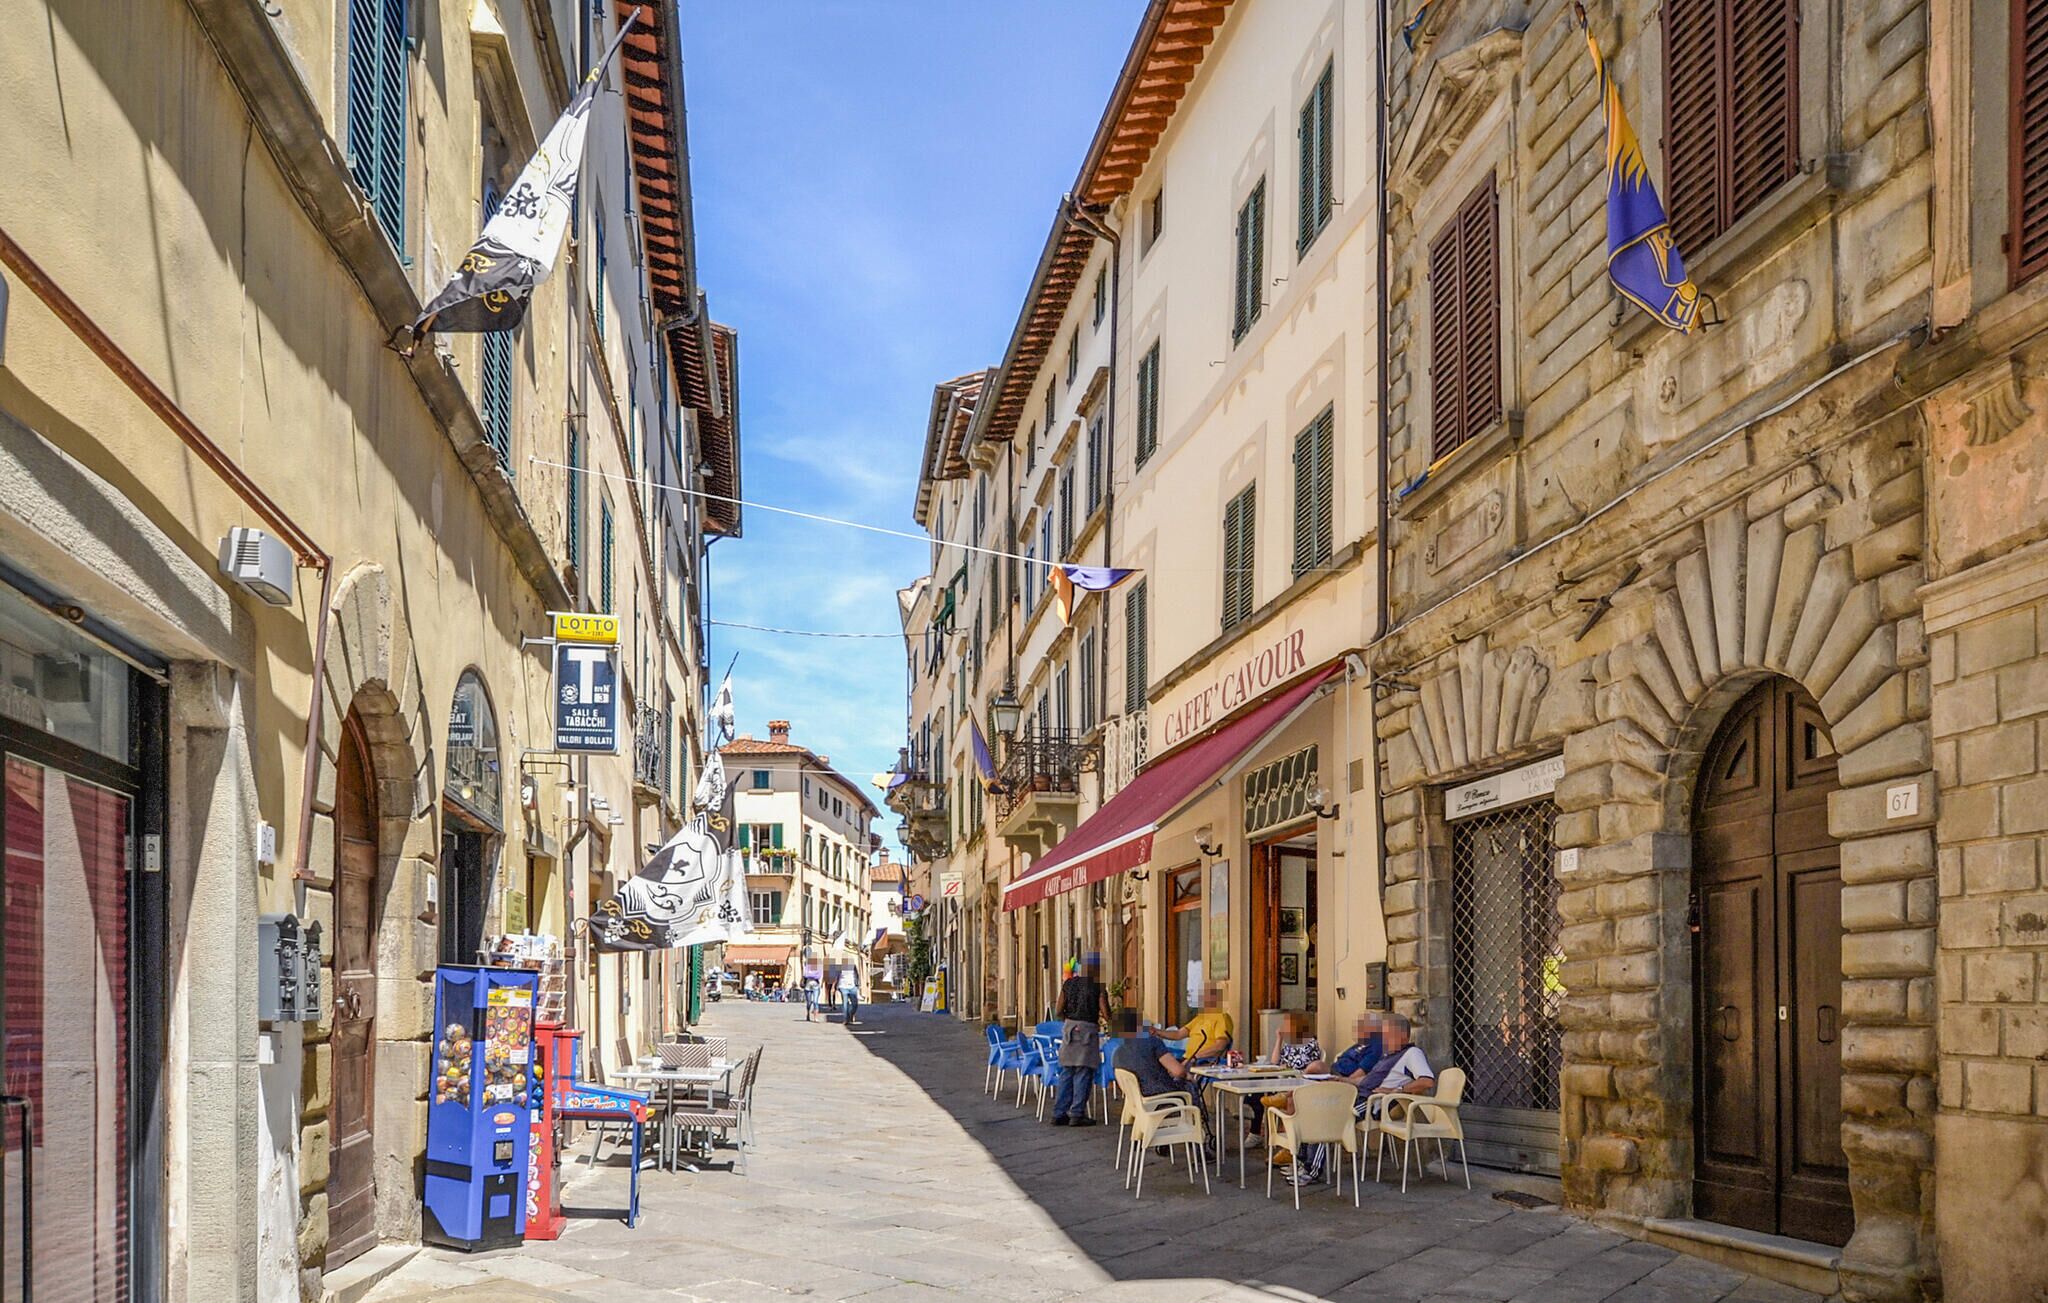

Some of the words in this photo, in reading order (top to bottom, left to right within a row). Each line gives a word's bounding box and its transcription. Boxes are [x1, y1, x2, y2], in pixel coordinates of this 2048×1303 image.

[560, 618, 614, 631] LOTTO
[1164, 682, 1218, 746] CAFFE'
[1221, 628, 1306, 711] CAVOUR
[571, 708, 589, 716] SALI
[592, 709, 599, 717] E
[565, 716, 606, 728] TABACCHI
[558, 735, 582, 744] VALORI
[584, 736, 613, 745] BOLLATI
[1891, 792, 1911, 811] 67
